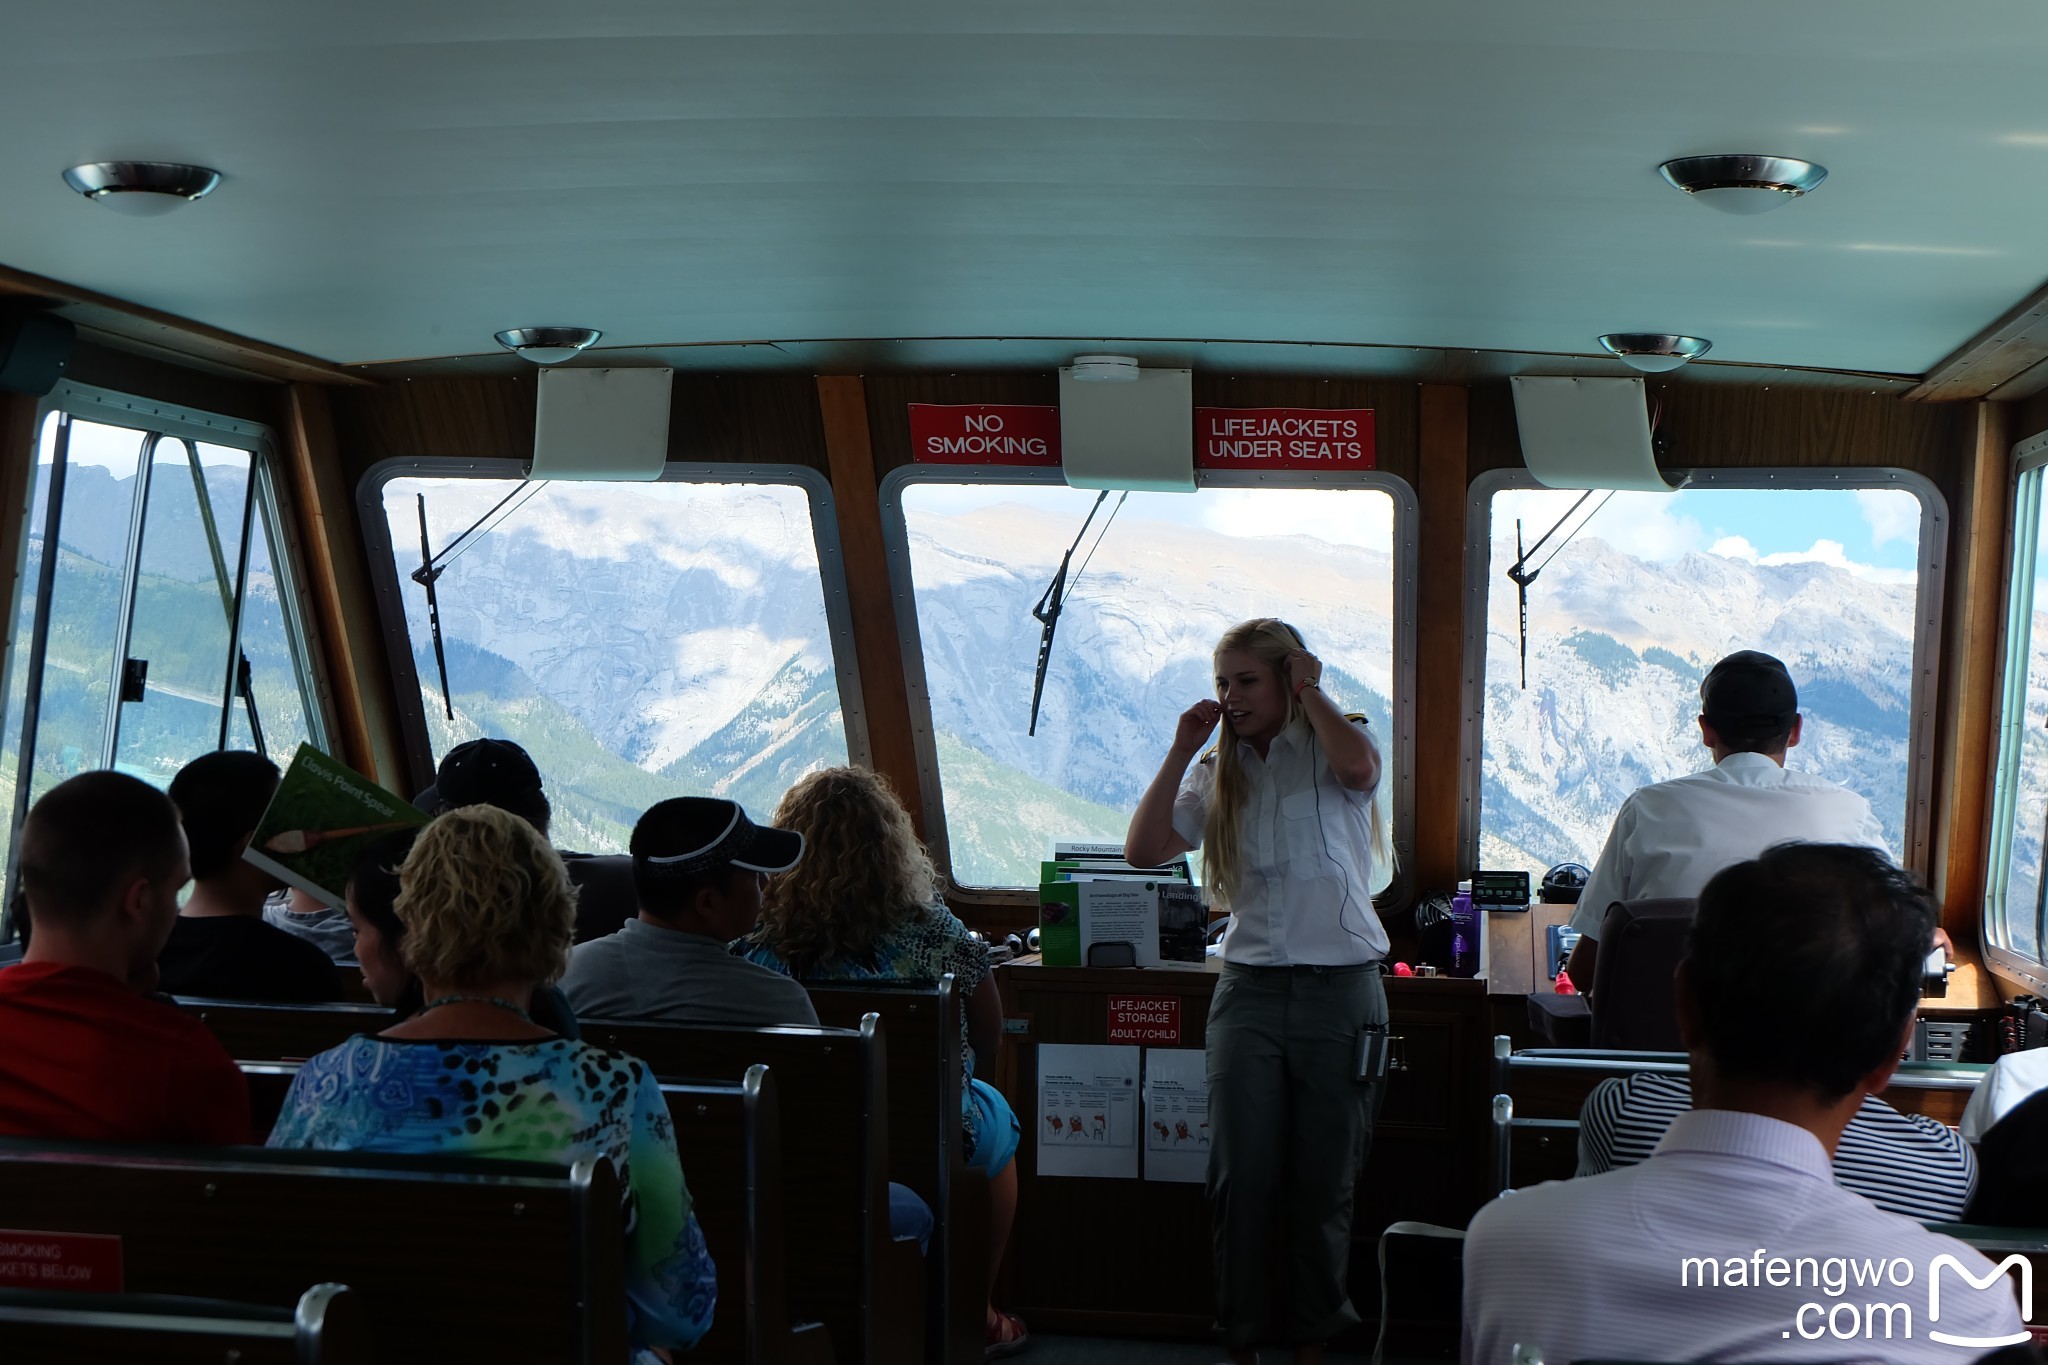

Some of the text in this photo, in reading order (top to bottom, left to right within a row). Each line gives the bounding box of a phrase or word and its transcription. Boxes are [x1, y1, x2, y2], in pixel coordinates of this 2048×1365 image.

[964, 414, 1004, 433] NO
[1211, 417, 1358, 438] LIFEJACKETS
[926, 436, 1047, 456] SMOKING
[1208, 440, 1362, 460] UNDER SEATS
[301, 755, 396, 817] Clovis Point Spear
[1071, 845, 1122, 853] Rocky Mountain
[1161, 891, 1199, 902] Landing
[1455, 933, 1463, 968] everyday
[1110, 1000, 1177, 1011] LIFEJACKET
[1117, 1013, 1170, 1023] STORAGE
[1110, 1029, 1177, 1039] ADULT/CHILD
[42, 1263, 92, 1279] BELOW
